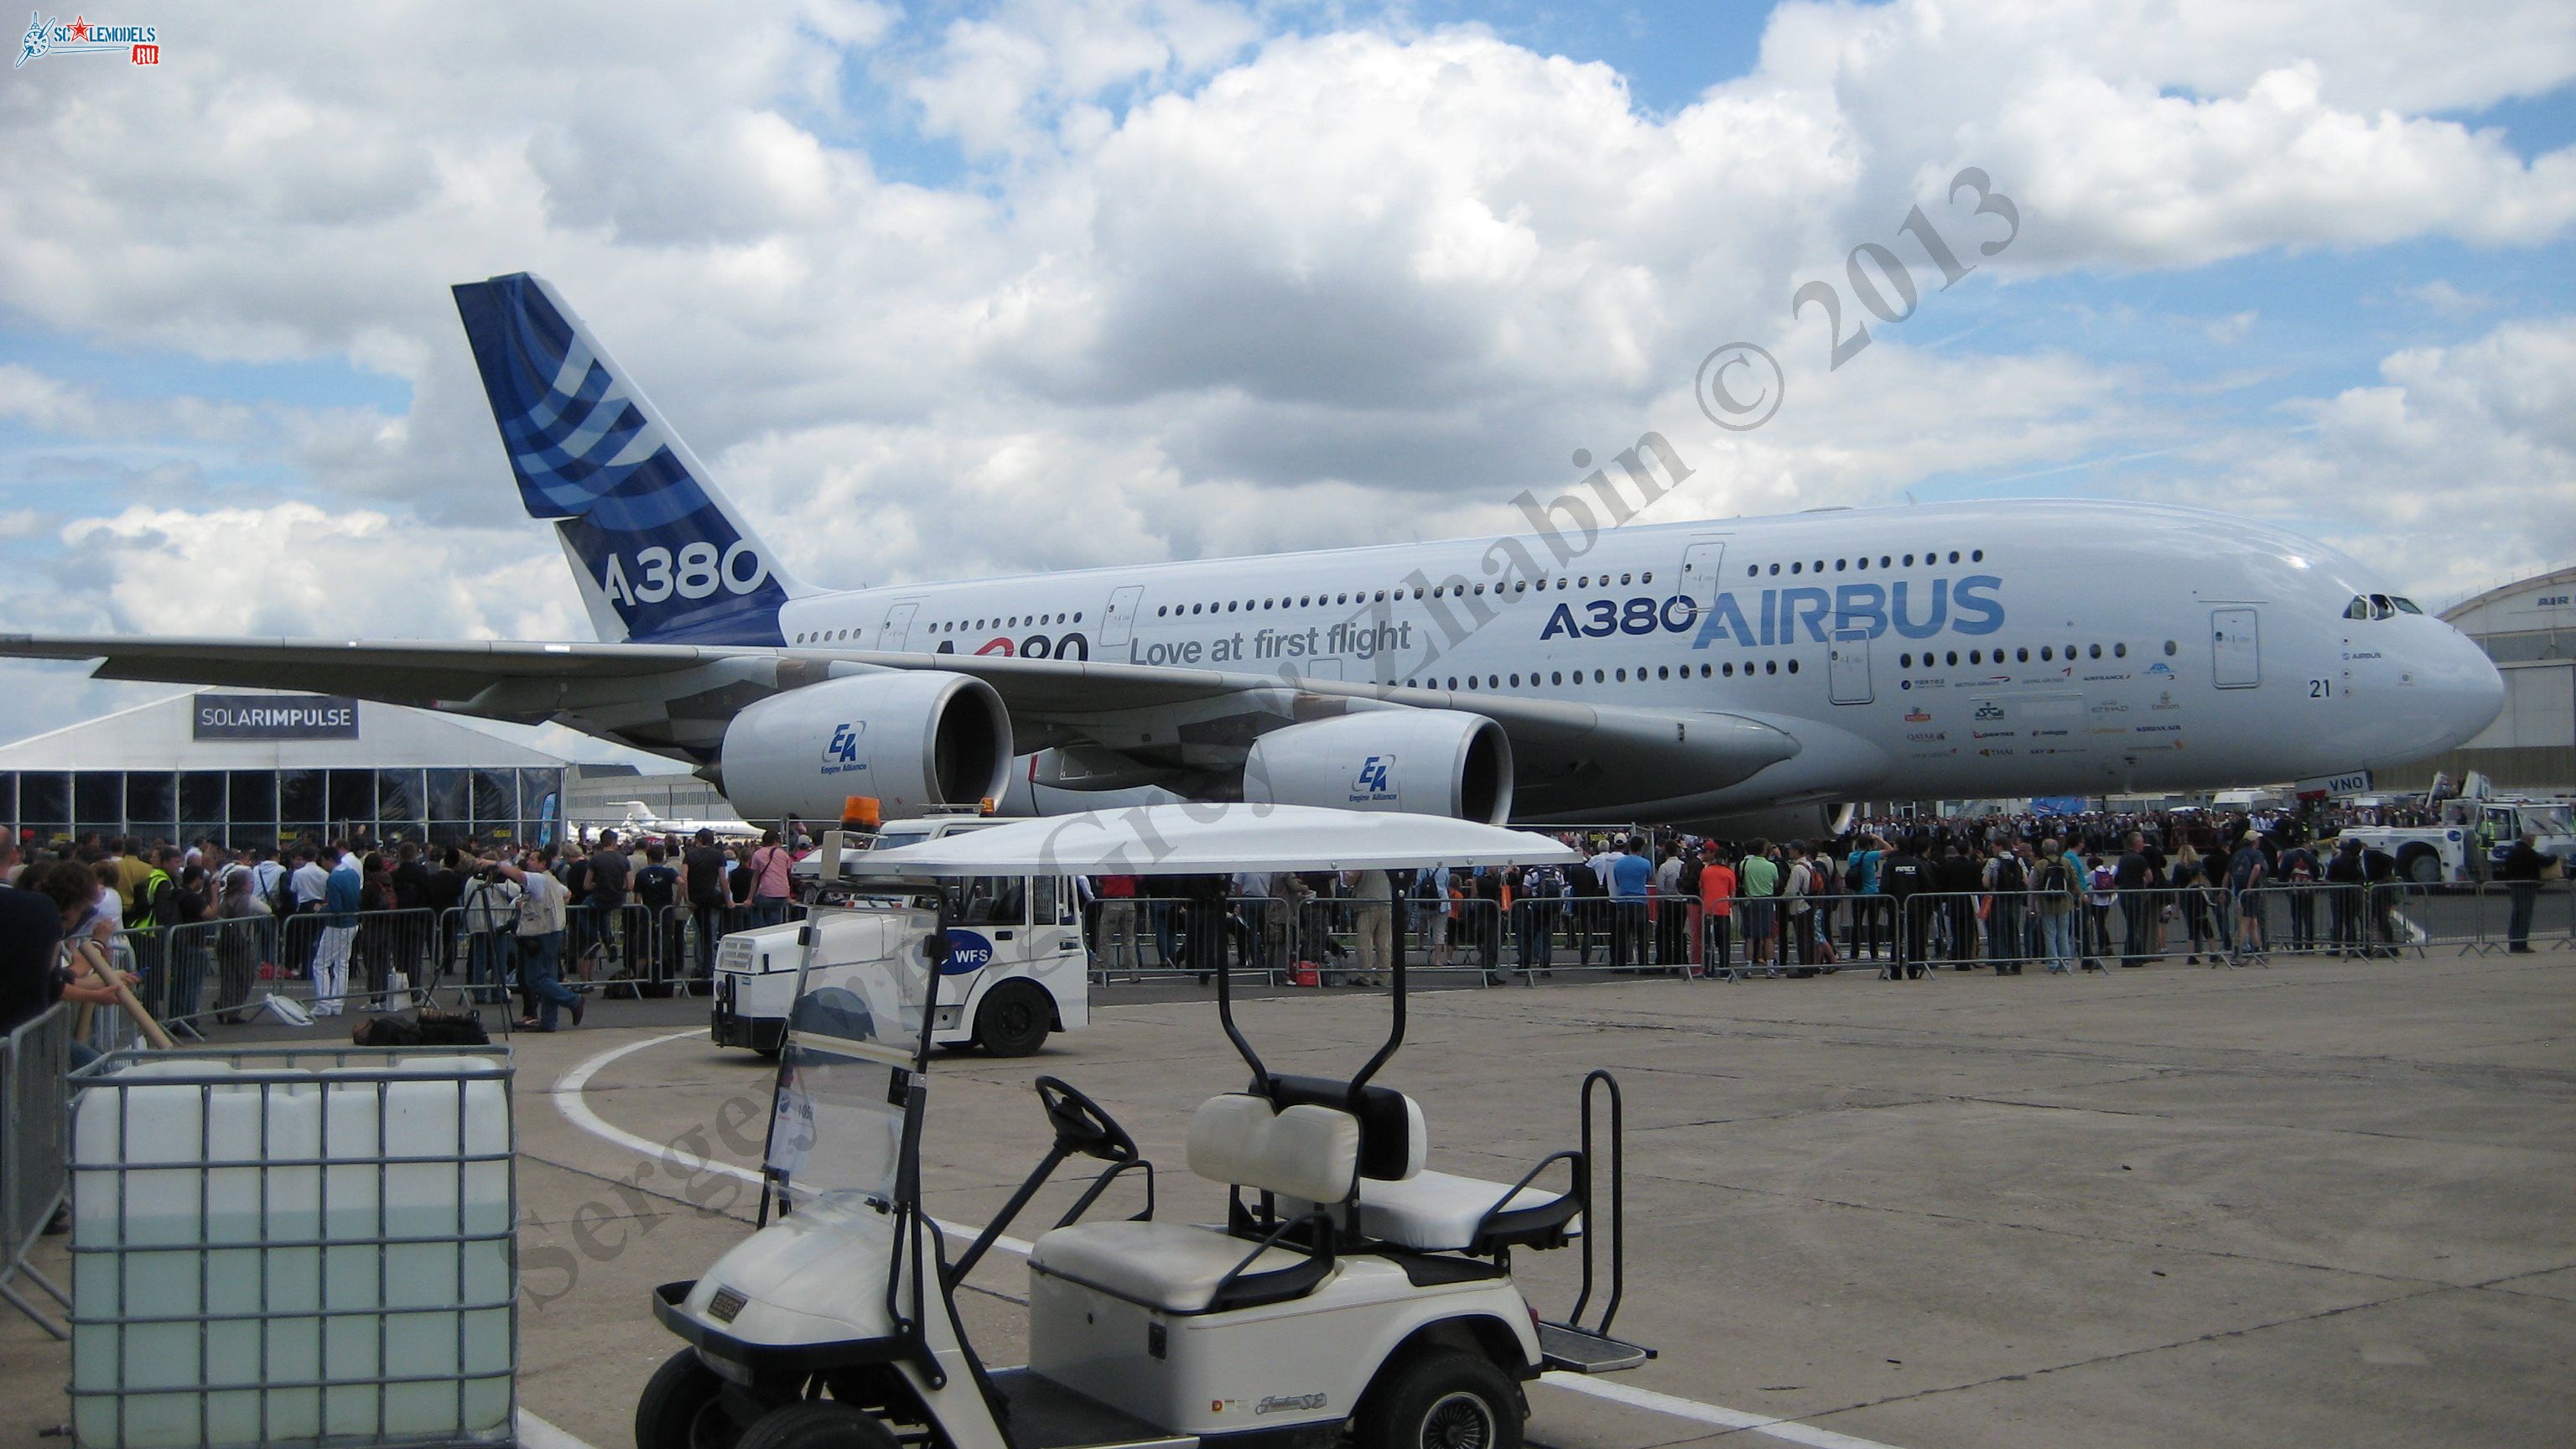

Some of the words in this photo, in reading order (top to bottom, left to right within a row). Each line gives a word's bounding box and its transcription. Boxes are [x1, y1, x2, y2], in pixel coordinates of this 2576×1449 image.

[603, 539, 769, 605] A380
[1540, 595, 1696, 640] A380
[1692, 574, 2005, 649] AIRBUS
[1130, 637, 1202, 666] Love
[1211, 631, 1243, 662] at
[1254, 626, 1317, 660] first
[1327, 621, 1412, 661] flight
[2309, 679, 2329, 698] 21
[202, 709, 351, 726] SOLARIMPULSE
[2329, 776, 2363, 792] VNO
[955, 949, 989, 963] WFS
